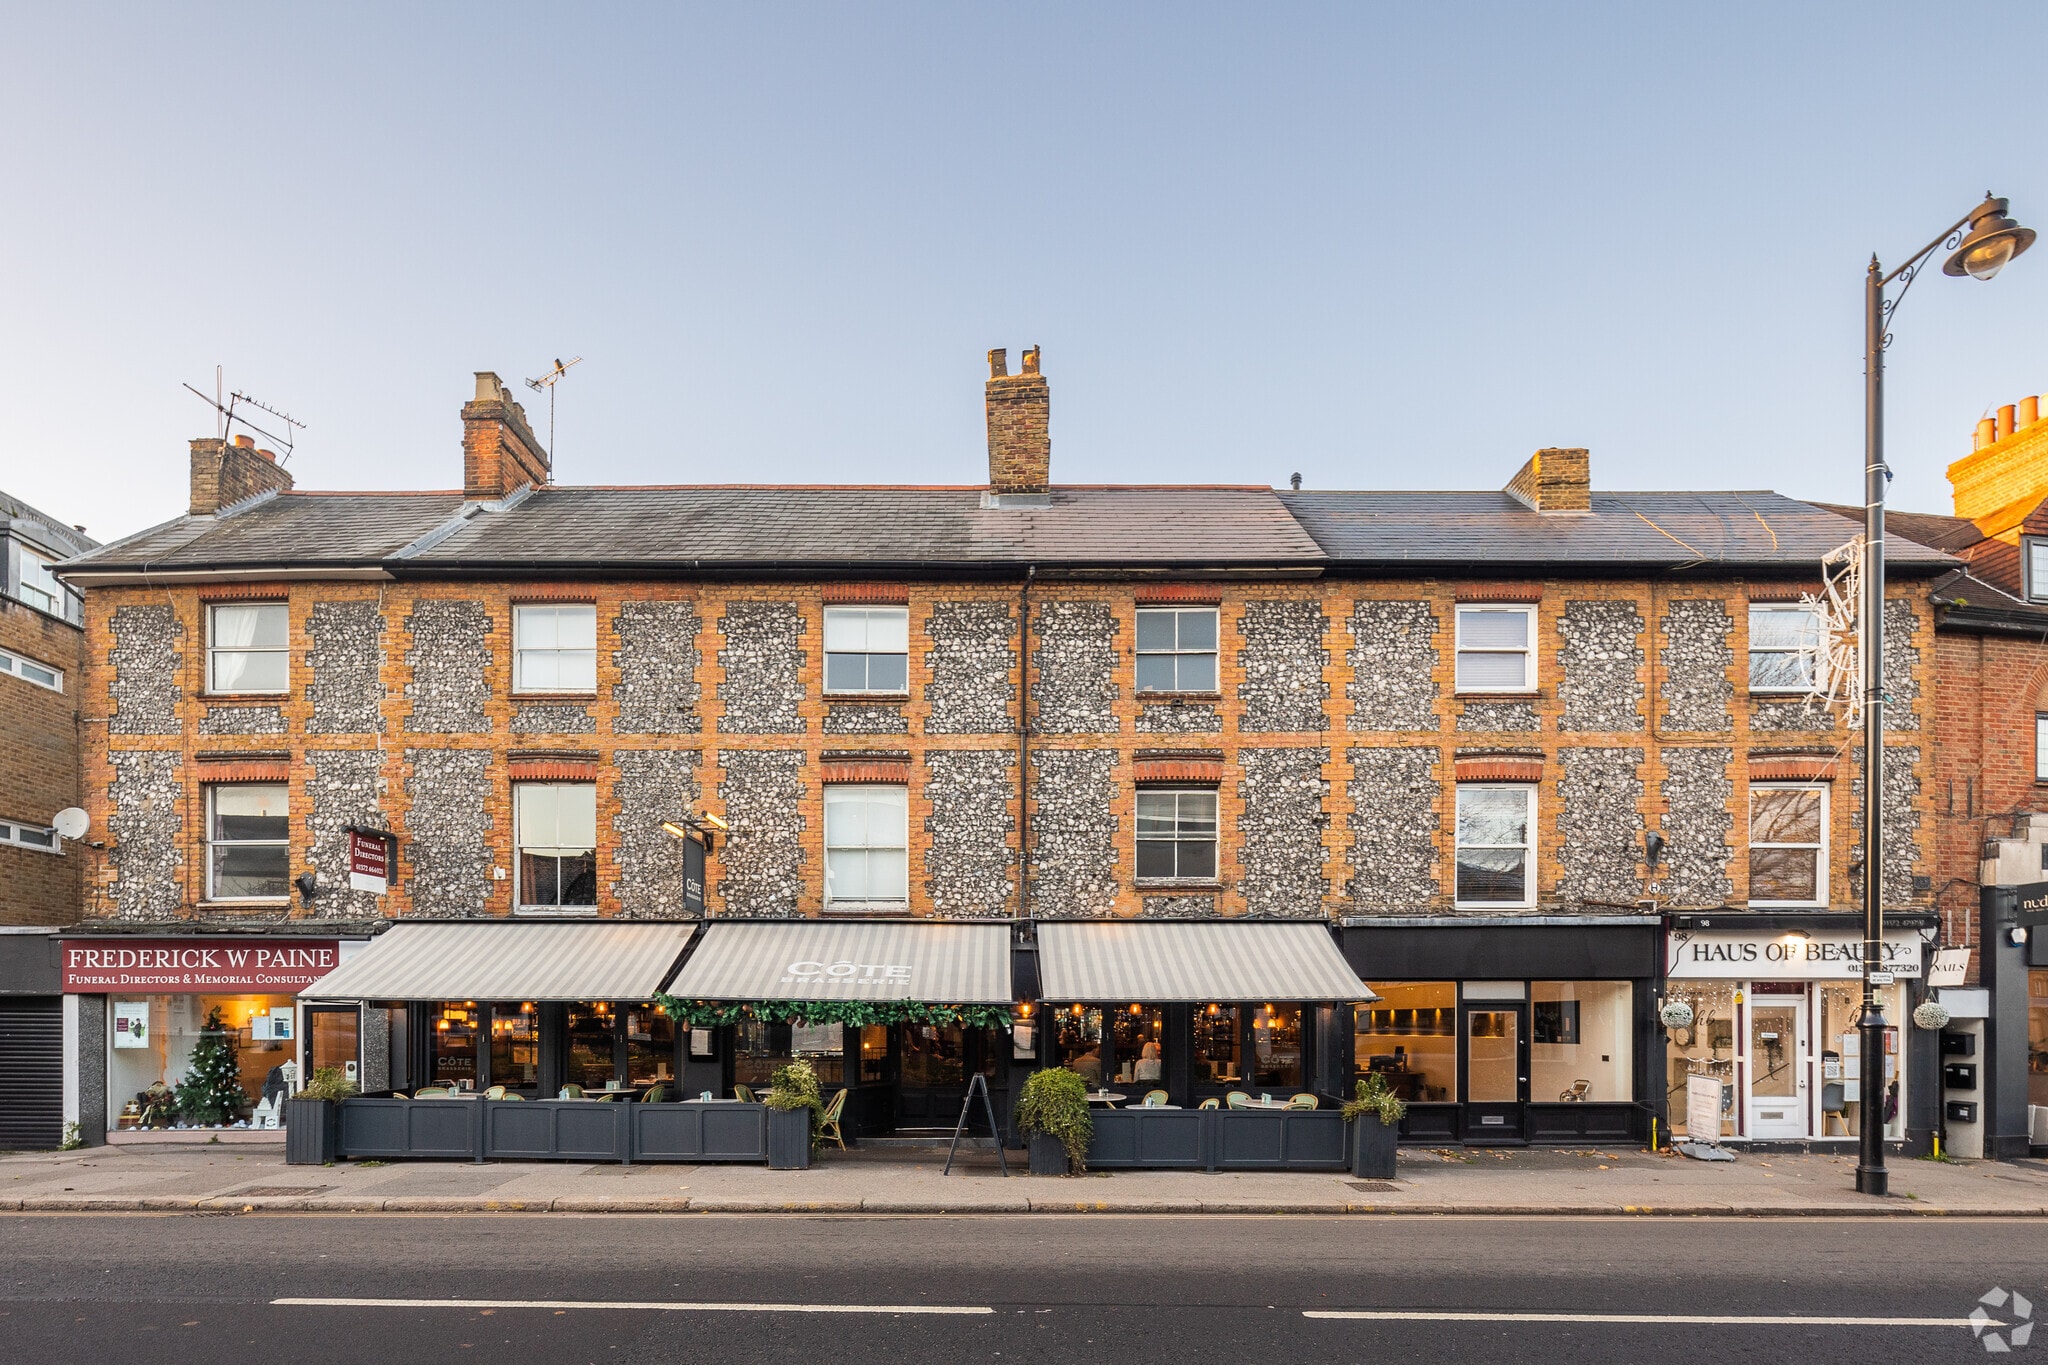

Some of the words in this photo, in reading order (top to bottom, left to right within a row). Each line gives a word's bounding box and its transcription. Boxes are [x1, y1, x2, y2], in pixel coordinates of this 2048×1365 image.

[357, 837, 382, 851] FUNERAL
[354, 847, 384, 862] DIRECTORS
[686, 878, 702, 895] CÔTE
[1700, 919, 1710, 927] 98
[1674, 932, 1688, 941] 98
[1693, 943, 1757, 961] HAUS
[1766, 943, 1797, 961] OF
[1805, 943, 1900, 960] BEAUY
[68, 949, 221, 968] FREDERICK
[225, 949, 251, 968] W
[255, 949, 334, 968] PAINE
[787, 960, 912, 978] CÔTE
[1882, 964, 1919, 972] 877320
[1932, 964, 1965, 972] NAILS
[68, 974, 118, 984] FUNERAL
[120, 974, 180, 984] DIRECTORS
[183, 974, 191, 984] &
[195, 974, 253, 984] MEMORIAL
[255, 974, 323, 984] CONSULTAN
[780, 977, 910, 985] BRASSERIE
[1694, 1009, 1716, 1026] hb
[438, 1056, 472, 1066] CÔTE
